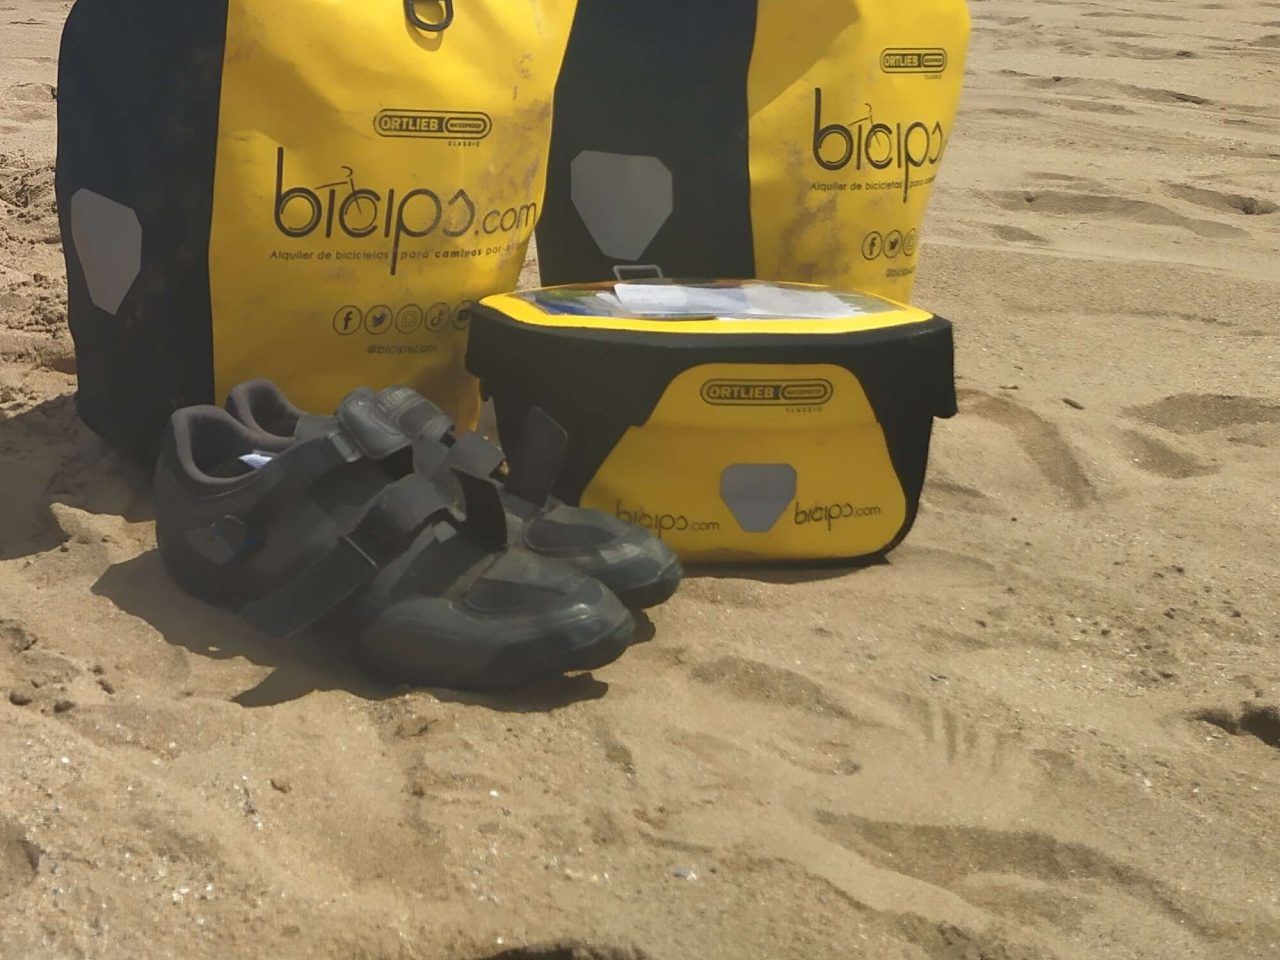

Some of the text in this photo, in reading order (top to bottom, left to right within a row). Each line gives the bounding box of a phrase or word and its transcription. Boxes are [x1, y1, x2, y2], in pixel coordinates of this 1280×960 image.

[883, 55, 919, 66] ORTLIEB
[381, 117, 439, 131] ORTLIEB
[850, 182, 862, 190] de
[270, 250, 314, 260] Alquiler
[317, 250, 331, 260] de
[400, 249, 429, 260] para
[709, 386, 774, 399] ORTLIEB
